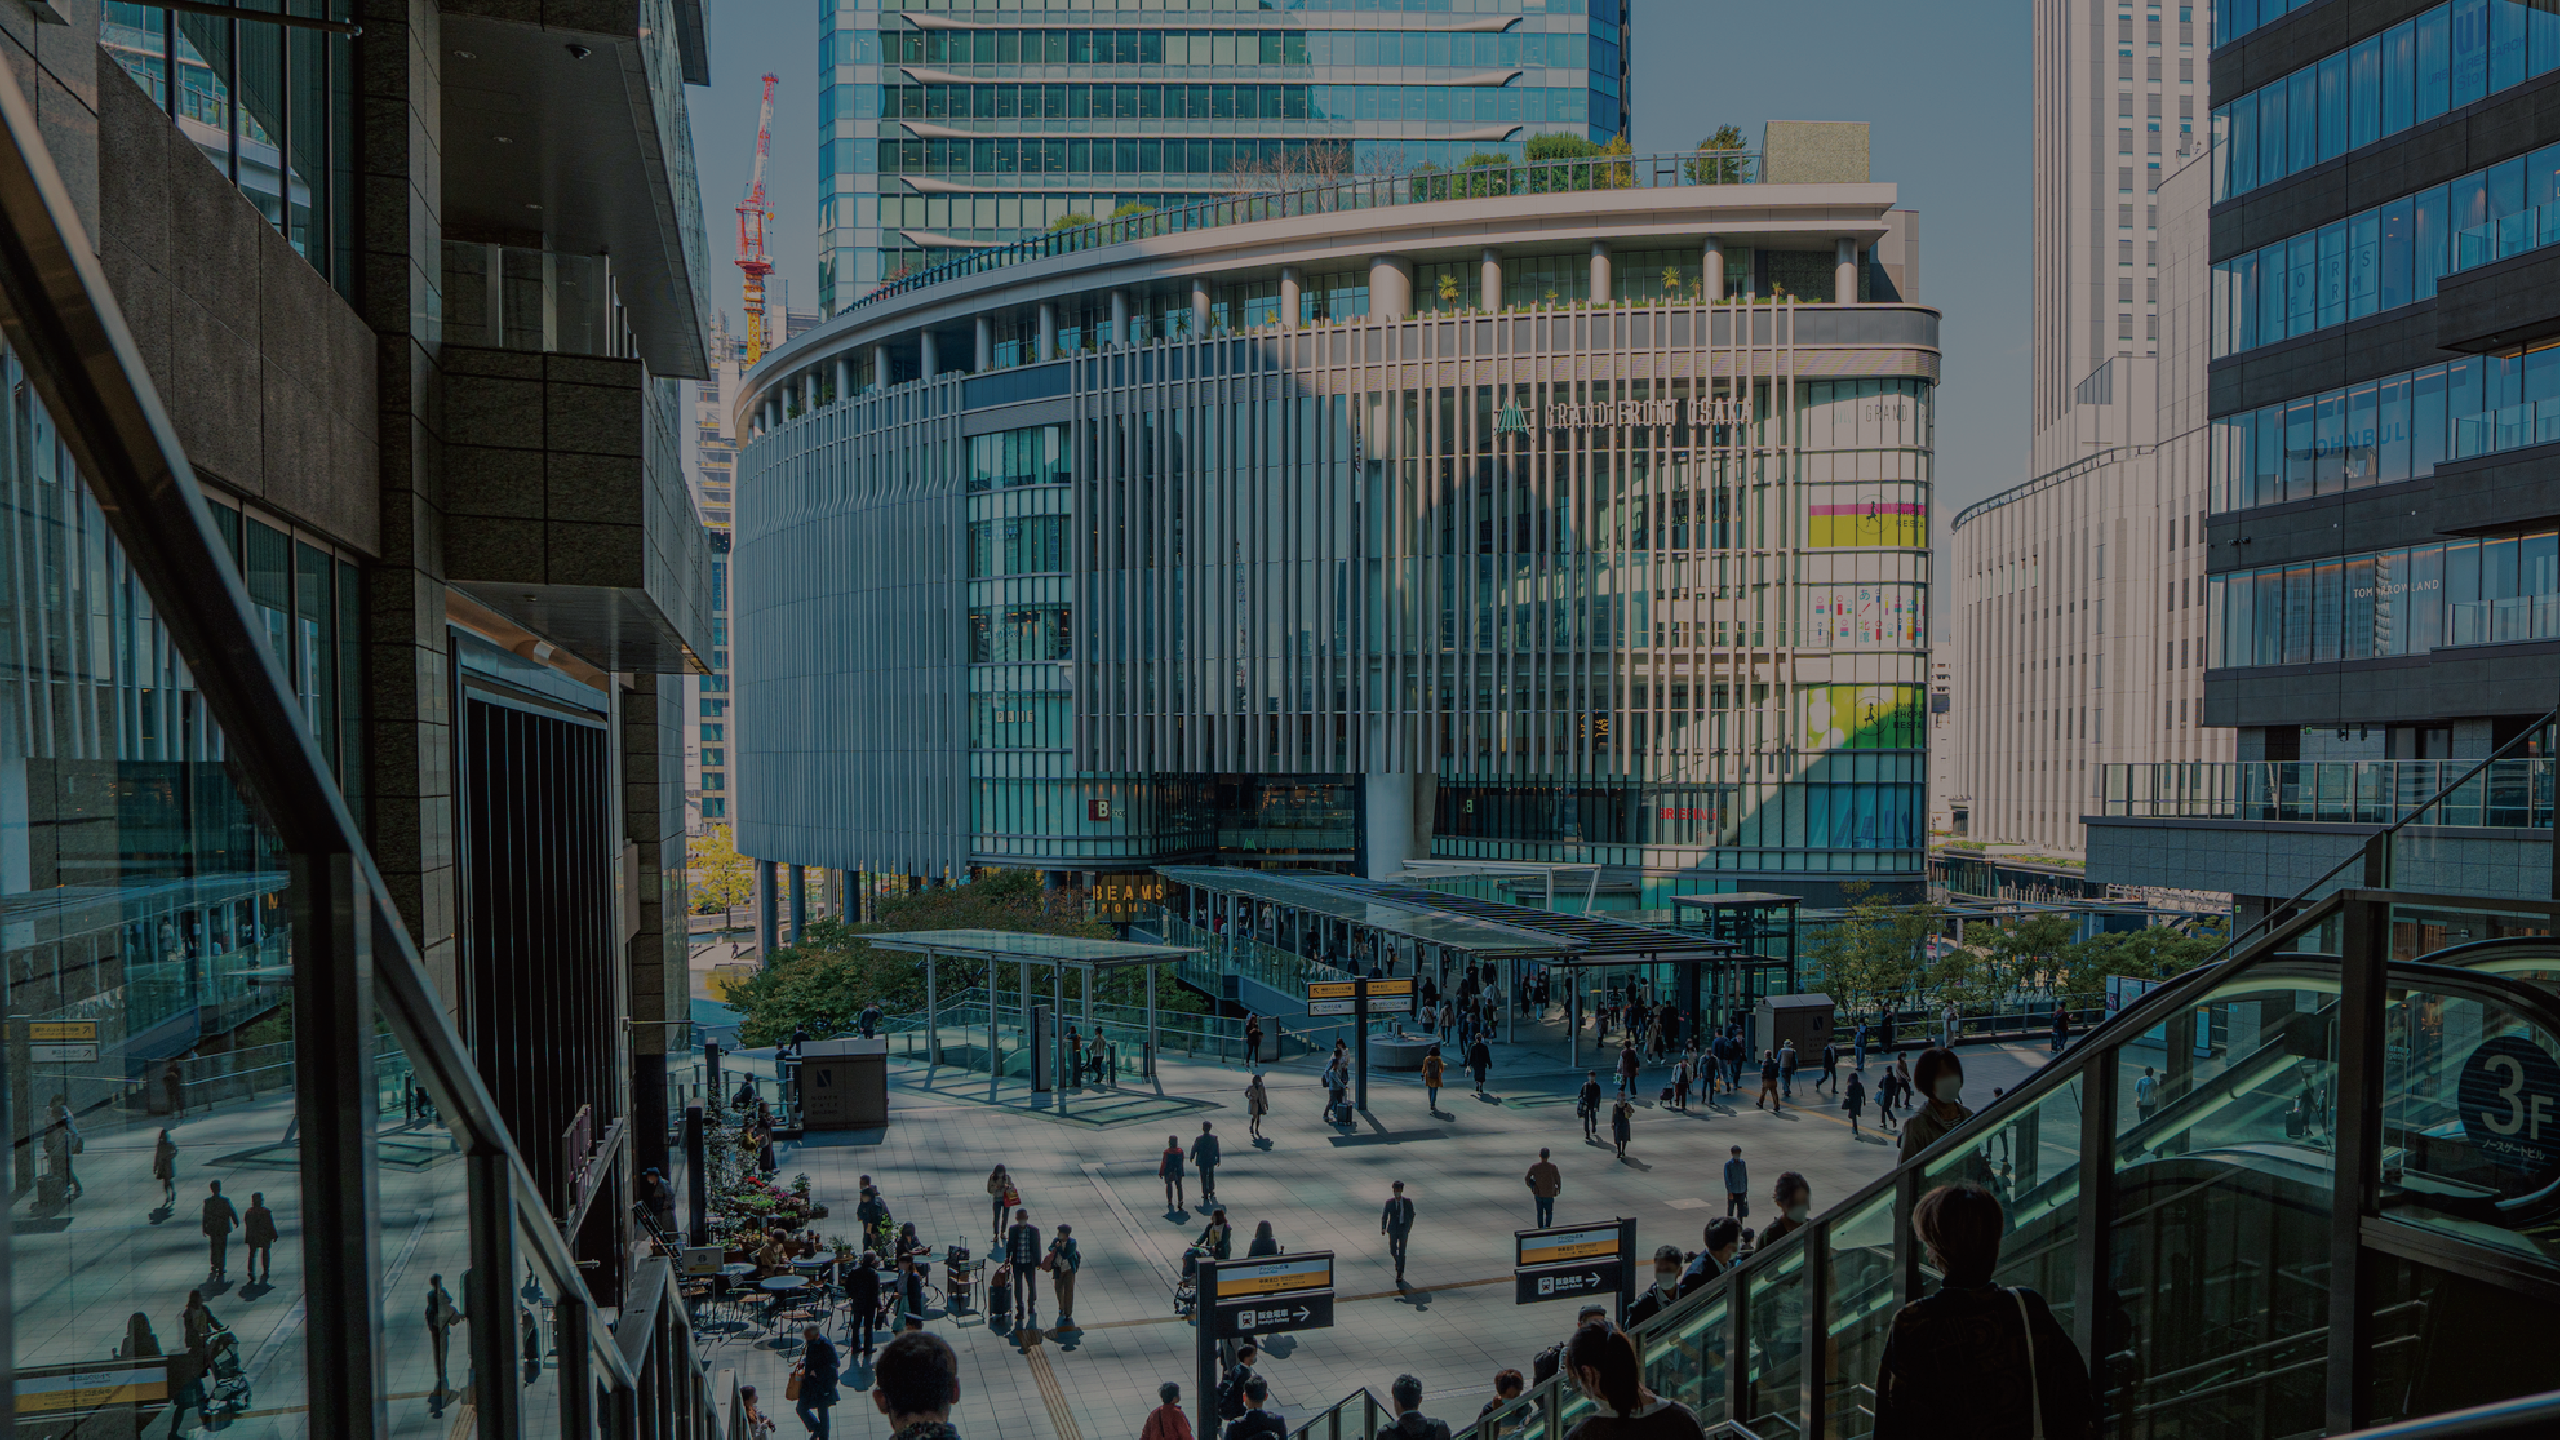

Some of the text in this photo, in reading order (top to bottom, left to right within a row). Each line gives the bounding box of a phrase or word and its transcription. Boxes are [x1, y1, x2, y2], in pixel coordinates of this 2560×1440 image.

[1544, 397, 1753, 430] GRAND FRONT OSAKA
[1865, 404, 1908, 423] GRAND
[2303, 420, 2418, 461] JOHNBULL
[1660, 807, 1716, 820] BREFING
[1092, 883, 1164, 901] BEAMS
[2481, 1054, 2554, 1141] 3F
[2481, 1138, 2546, 1160] ノースゲートビル
